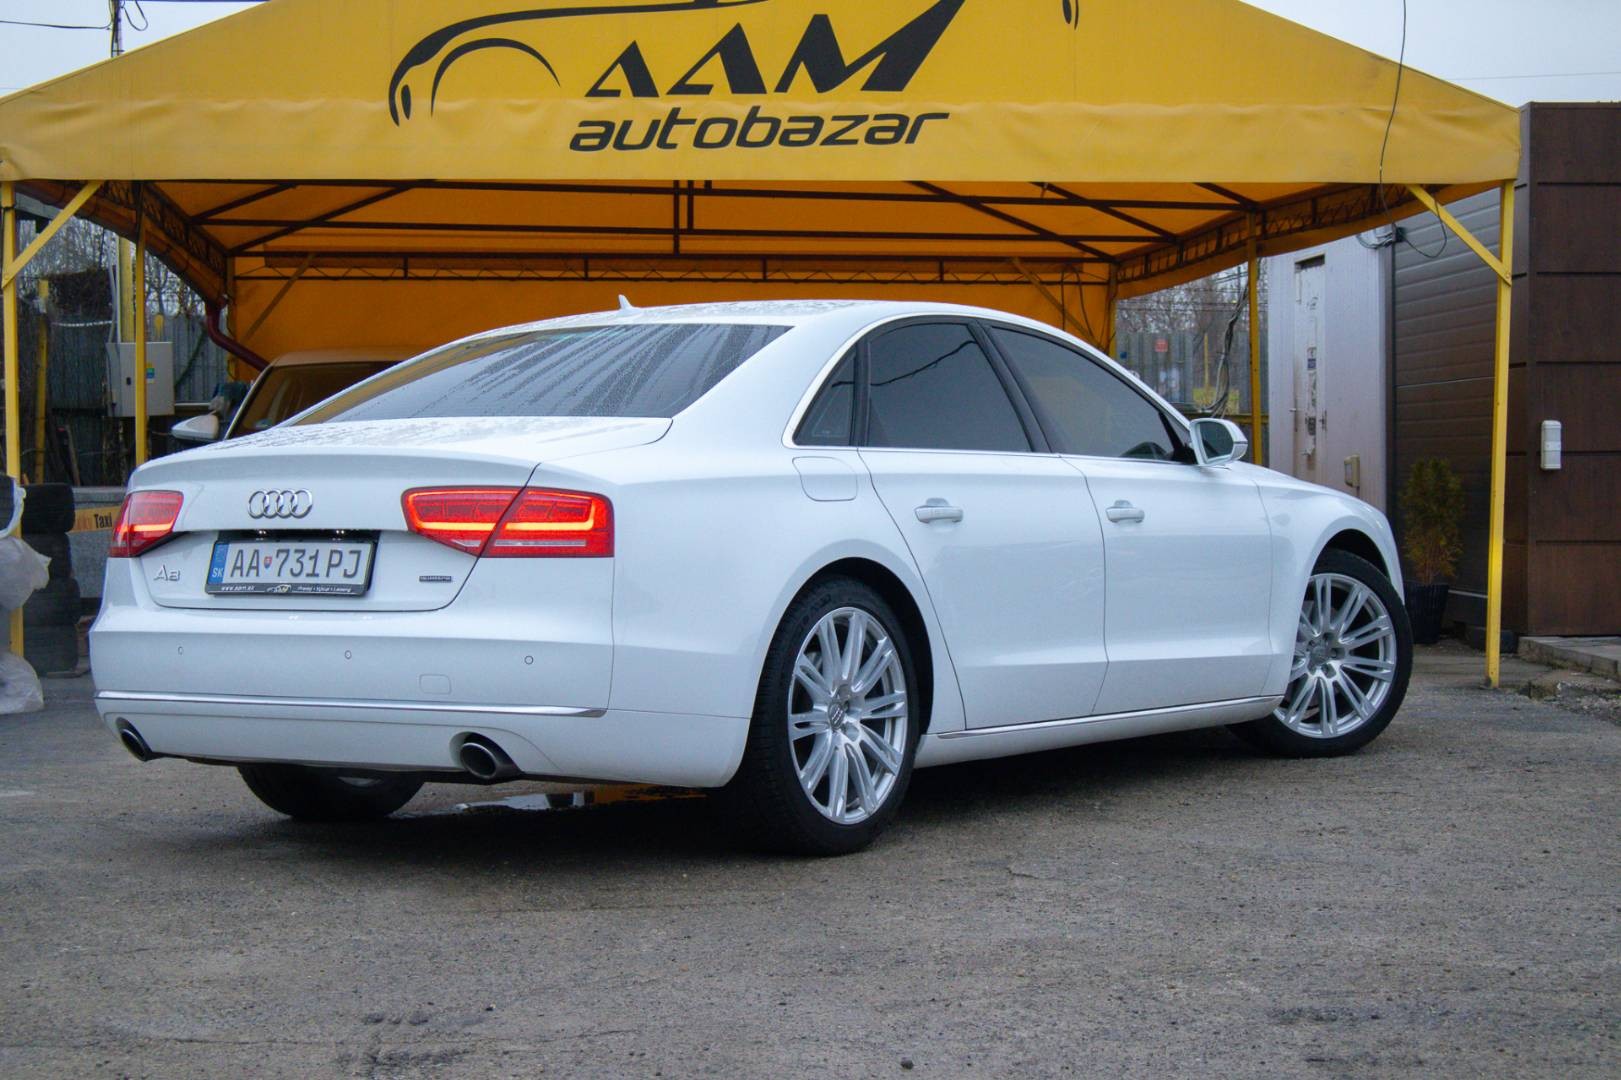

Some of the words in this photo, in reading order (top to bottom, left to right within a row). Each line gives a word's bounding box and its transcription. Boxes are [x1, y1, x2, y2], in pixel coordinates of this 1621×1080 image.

[584, 0, 966, 98] AAM
[569, 106, 950, 153] autobazar
[94, 512, 113, 529] Taxi
[153, 563, 181, 581] A8
[211, 567, 224, 578] SK
[230, 549, 260, 578] AA
[275, 548, 362, 578] 731PJ
